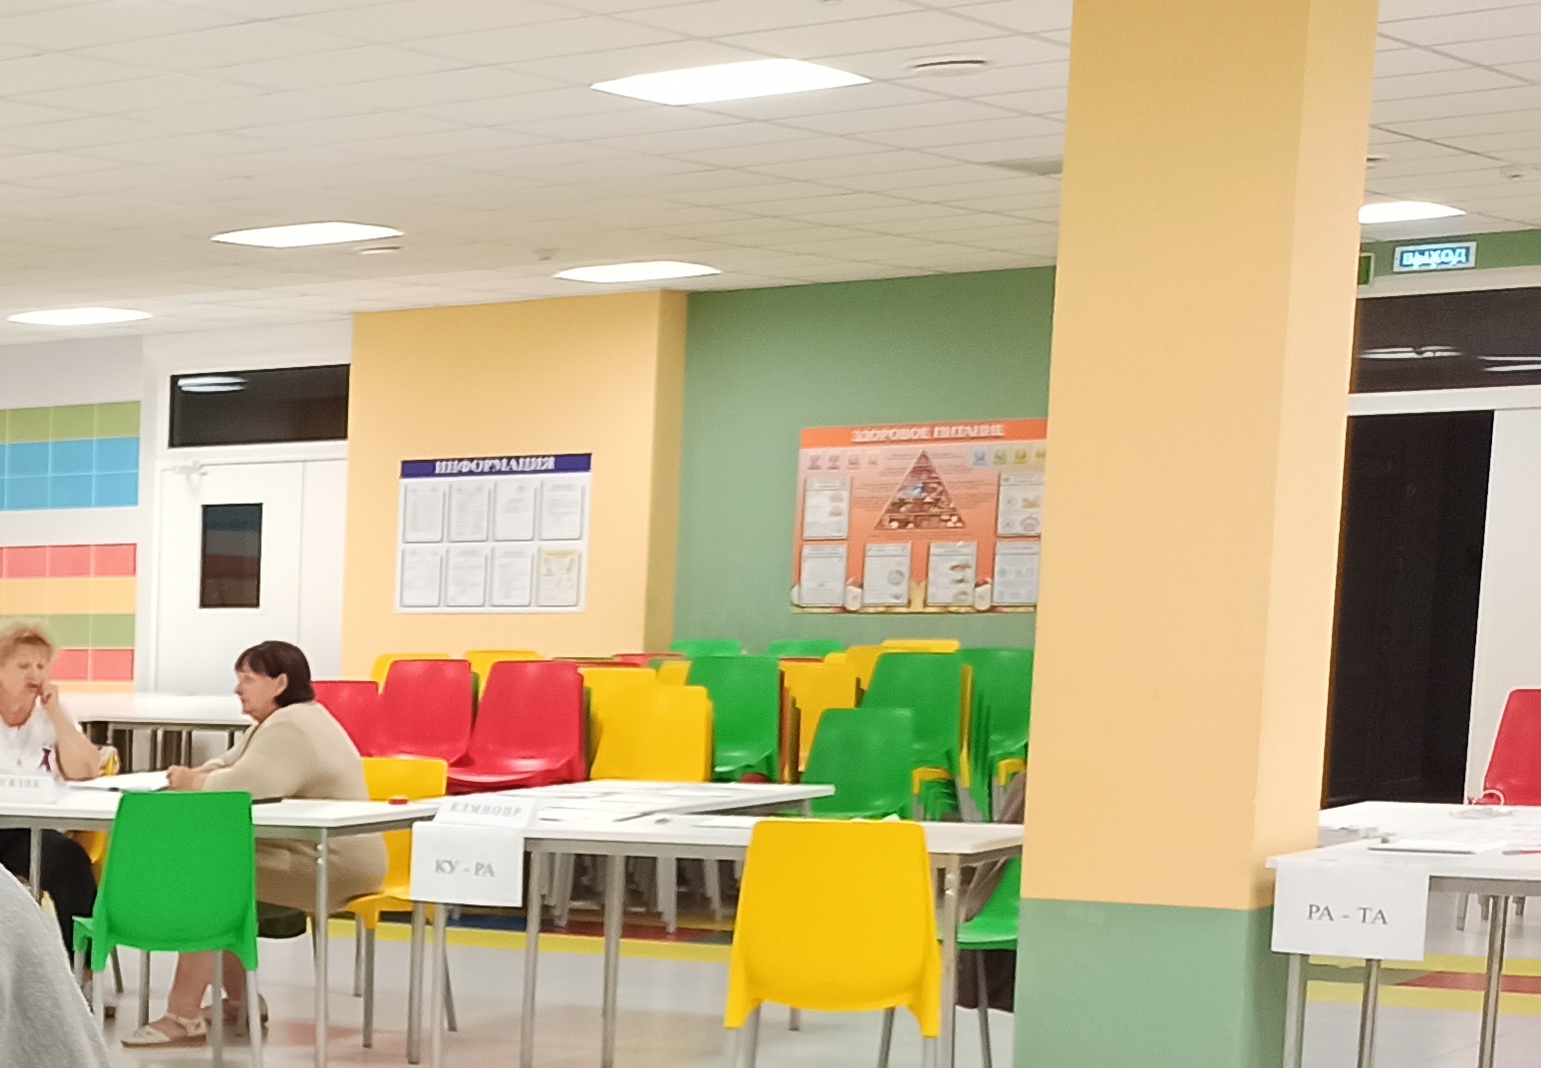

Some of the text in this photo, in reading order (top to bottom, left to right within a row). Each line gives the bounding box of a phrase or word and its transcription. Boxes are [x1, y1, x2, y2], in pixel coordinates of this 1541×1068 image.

[1402, 248, 1466, 266] ВЫХОД
[434, 456, 556, 474] ИНФОРМАЦИЯ
[1307, 903, 1334, 921] РА
[1357, 906, 1388, 925] ТА
